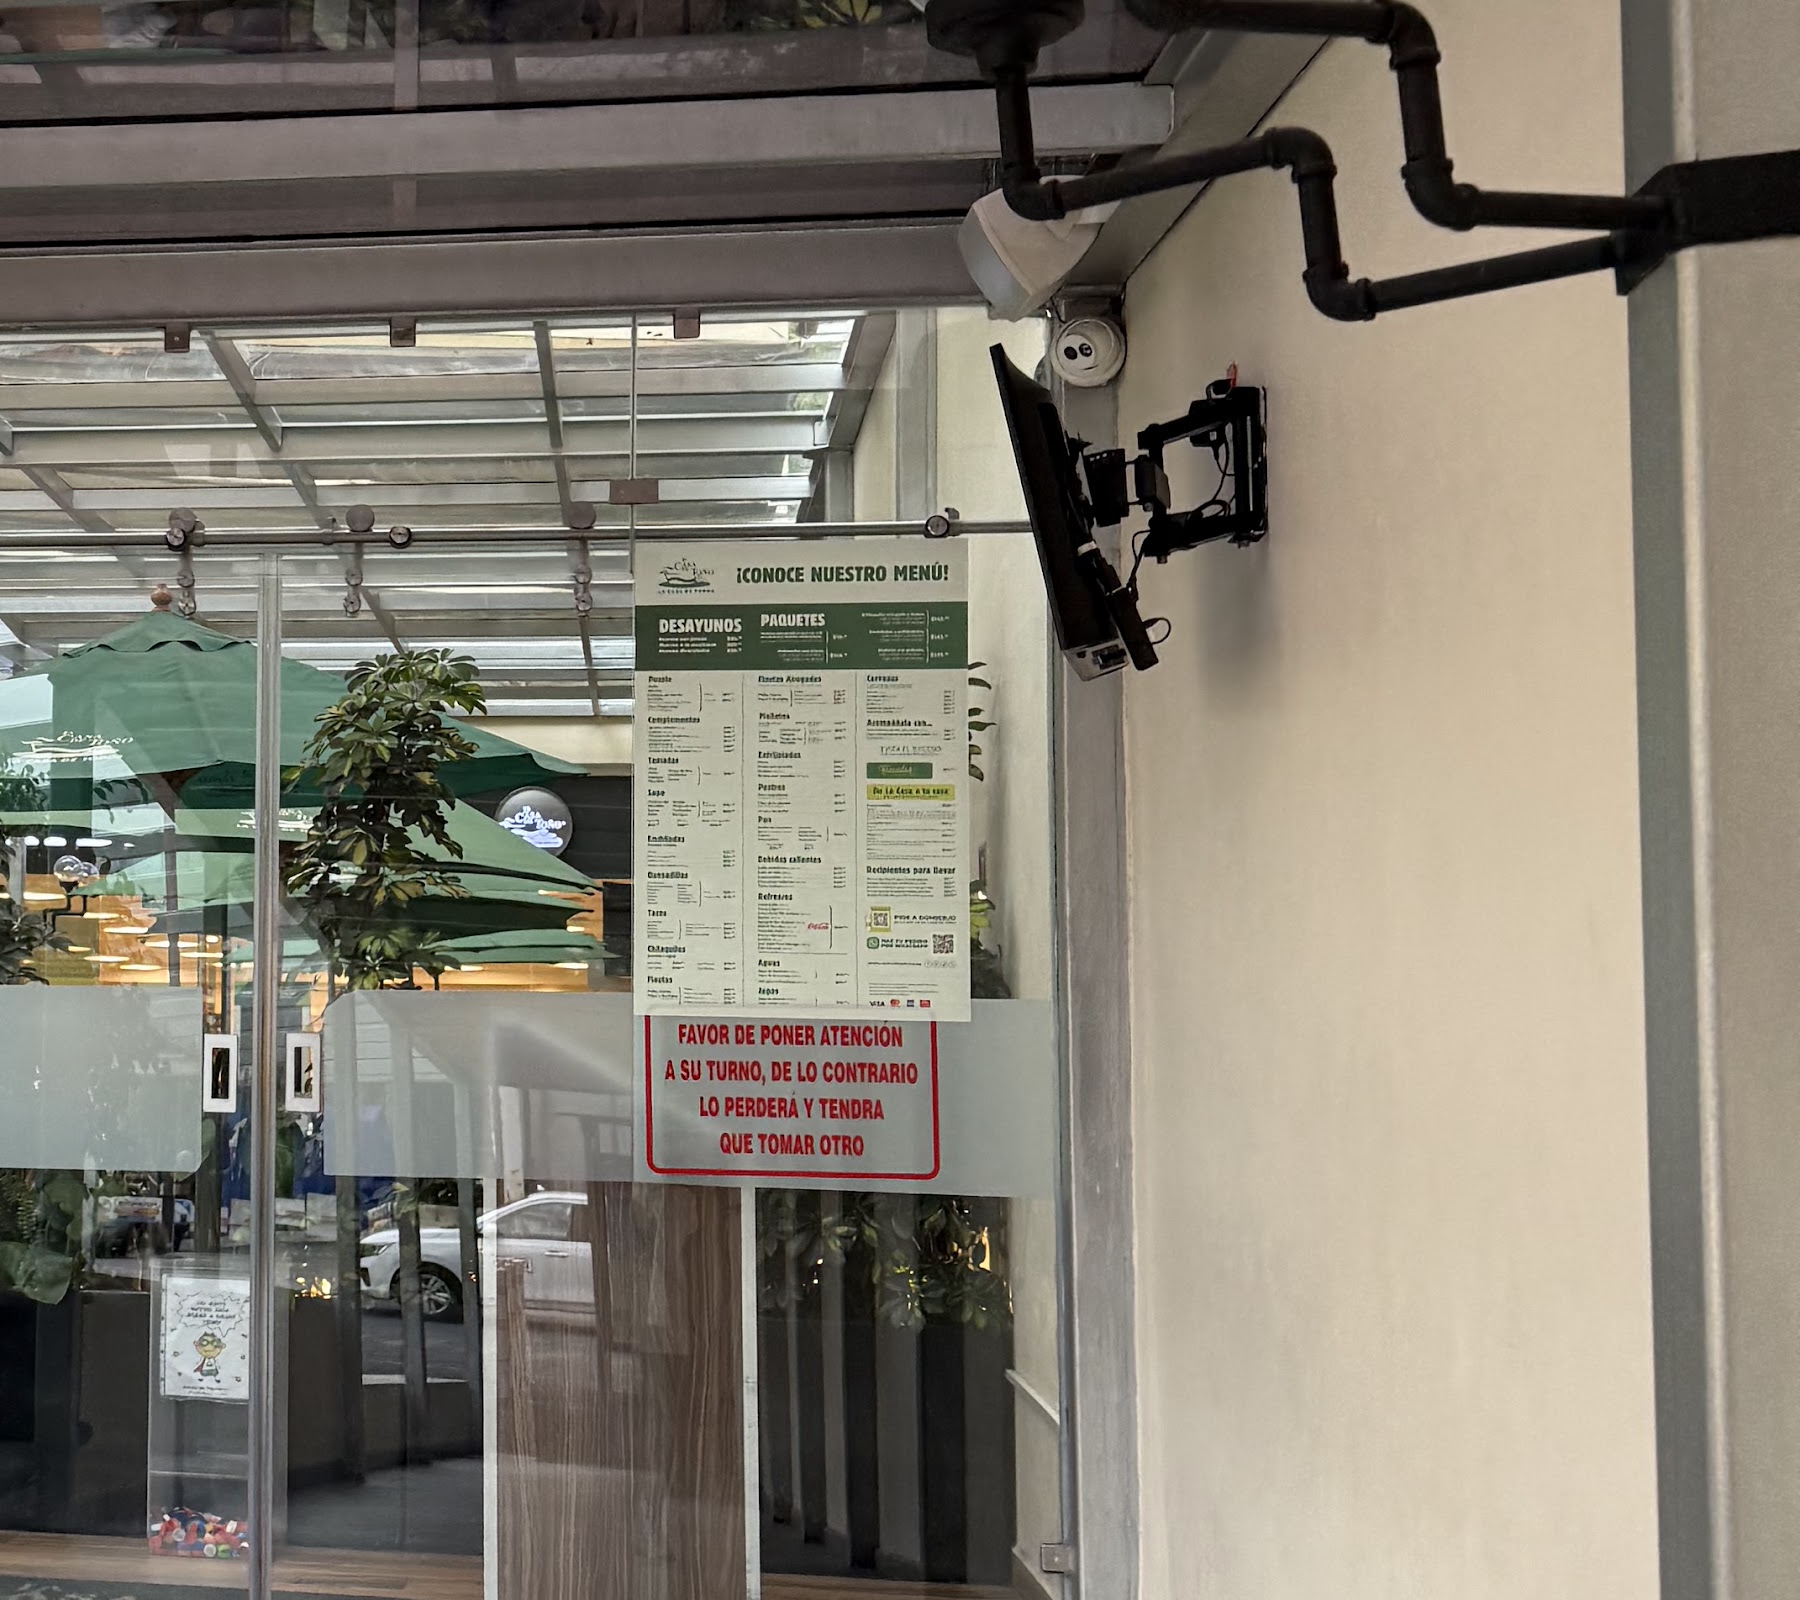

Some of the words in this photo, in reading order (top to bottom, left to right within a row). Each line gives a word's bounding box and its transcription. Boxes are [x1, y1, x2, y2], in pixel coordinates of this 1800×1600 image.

[737, 567, 804, 584] ¡CONOCE
[811, 565, 886, 582] NUESTRO
[894, 561, 948, 581] MENÚ!
[659, 618, 742, 633] DESAYUNOS
[760, 613, 826, 628] PAQUETES
[678, 1024, 729, 1045] FAVOR
[735, 1025, 755, 1045] DE
[760, 1025, 815, 1046] PONER
[821, 1020, 903, 1047] ATENCIÓN
[665, 1060, 675, 1080] A
[681, 1060, 701, 1081] SU
[706, 1061, 766, 1086] TURNO,
[772, 1062, 792, 1082] DE
[797, 1062, 818, 1083] LO
[822, 1062, 918, 1084] CONTRARIO
[699, 1097, 719, 1117] LO
[725, 1090, 797, 1118] PERDERÁ
[804, 1098, 815, 1118] Y
[819, 1098, 885, 1120] TENDRA
[720, 1133, 753, 1154] QUE
[758, 1134, 815, 1155] TOMAR
[820, 1135, 864, 1156] OTRO
